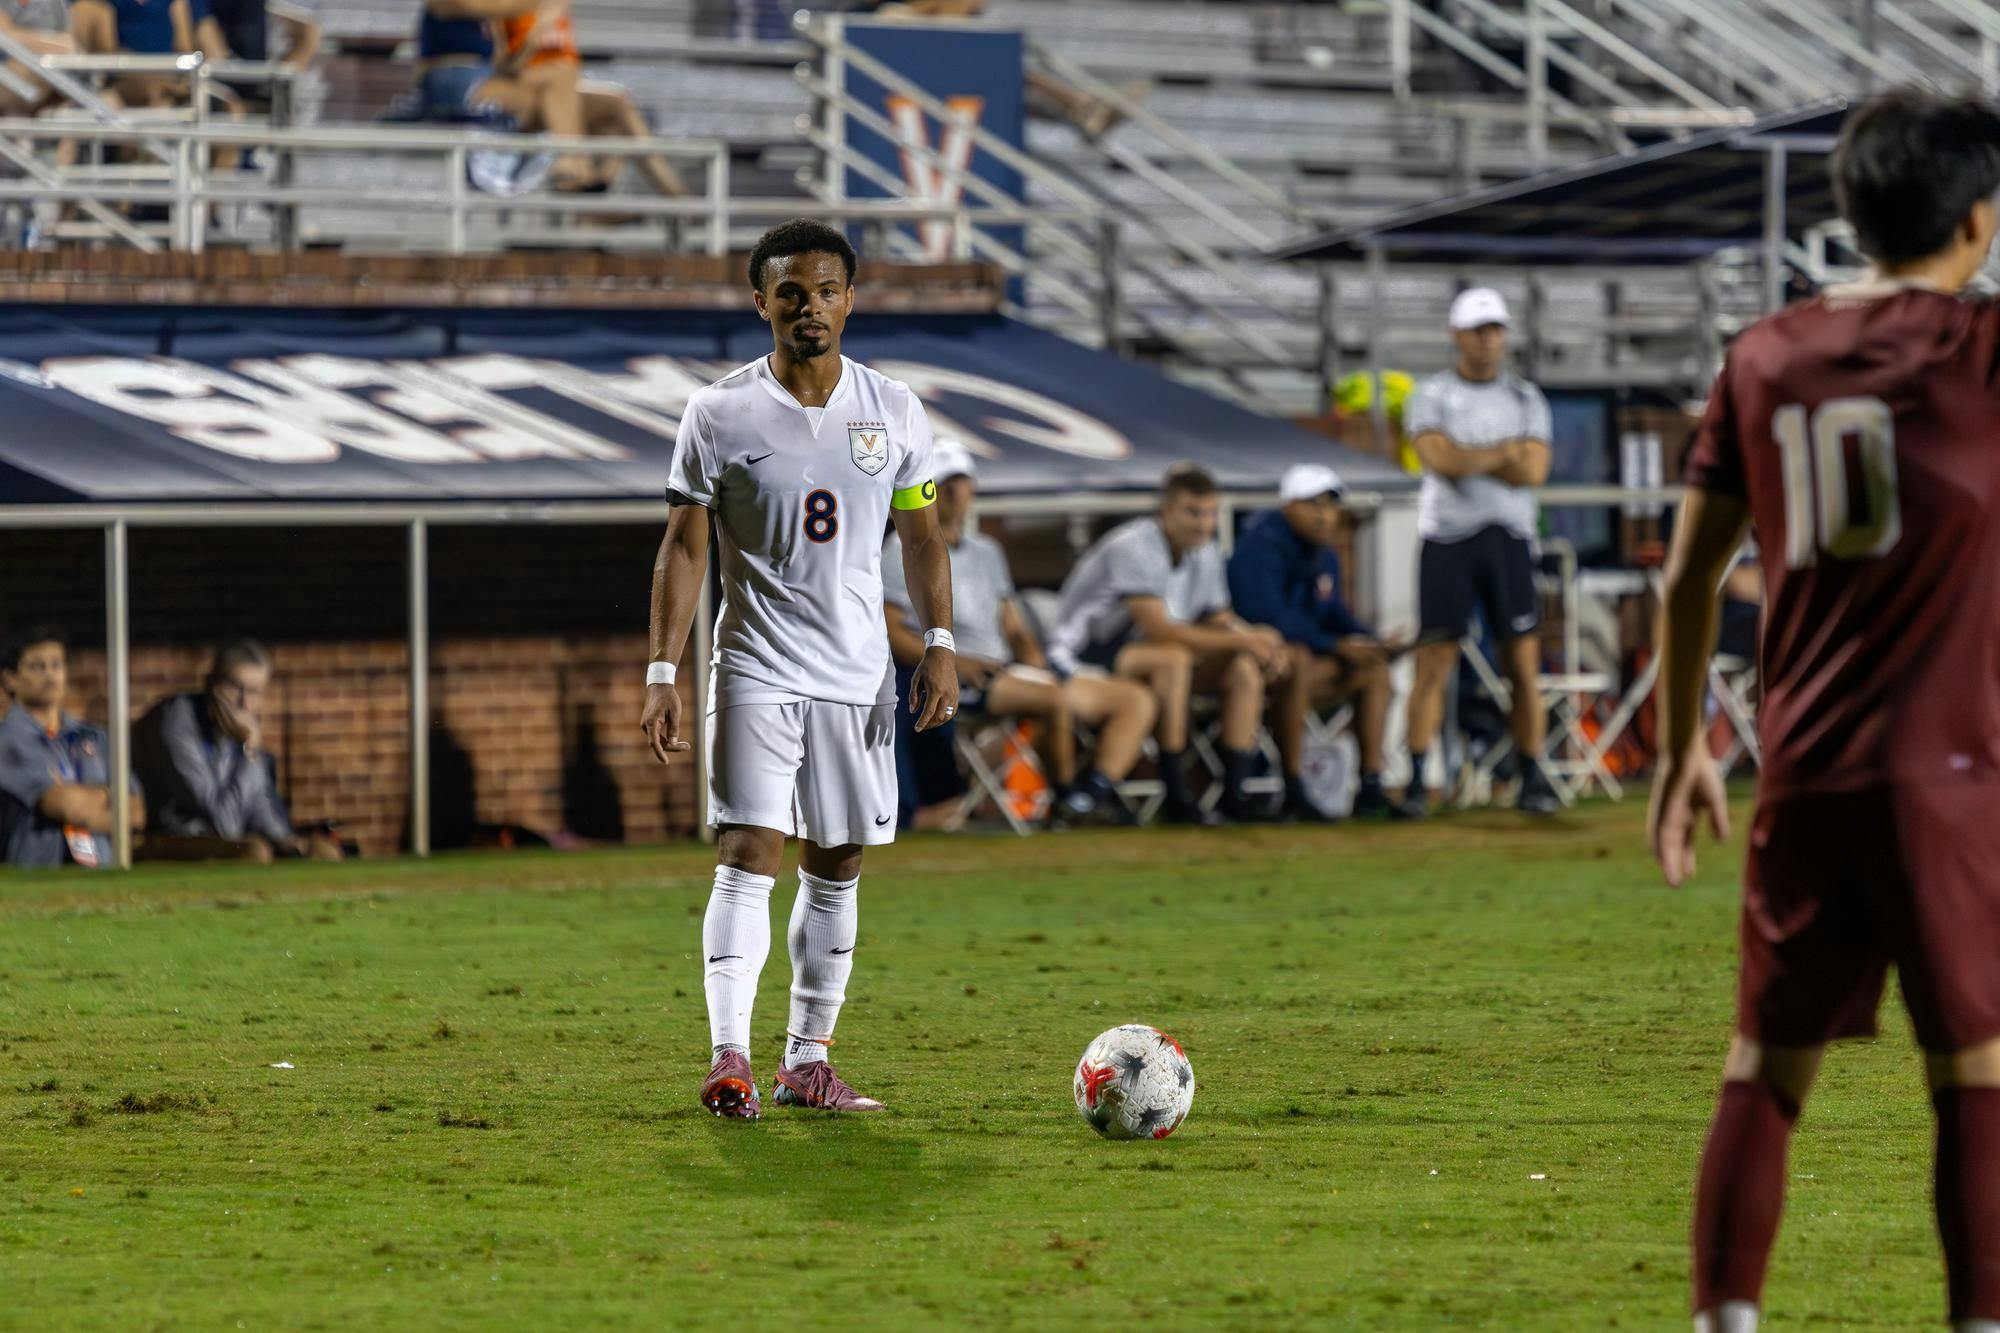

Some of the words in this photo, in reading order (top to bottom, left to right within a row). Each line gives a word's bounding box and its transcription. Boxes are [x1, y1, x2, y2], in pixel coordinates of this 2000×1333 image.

[860, 434, 878, 452] V
[921, 479, 935, 500] C
[1772, 395, 1902, 568] 10
[804, 489, 838, 542] 8
